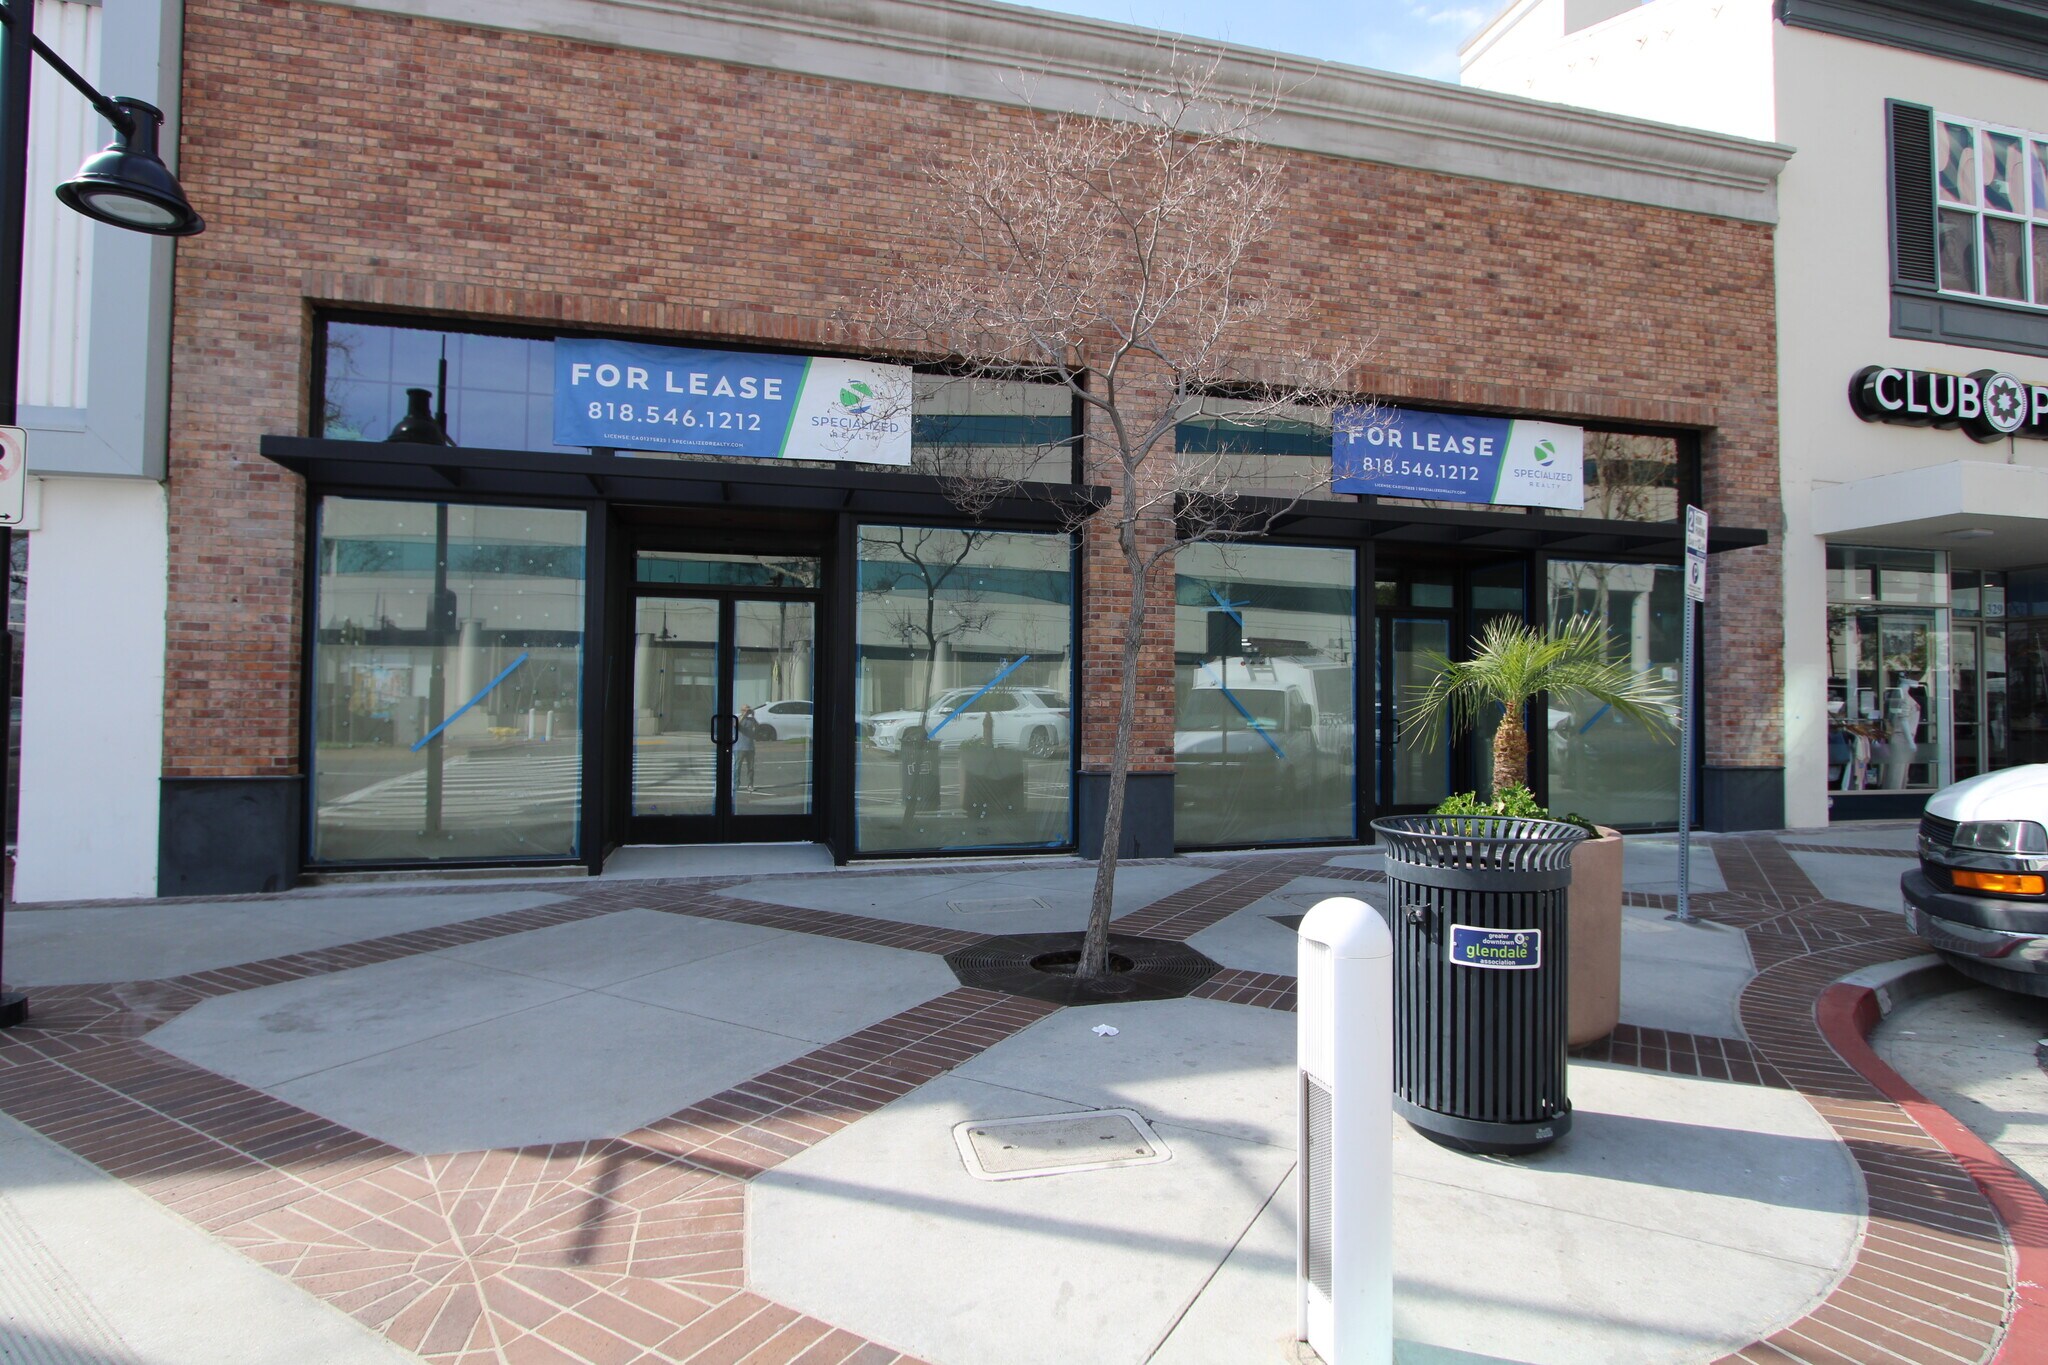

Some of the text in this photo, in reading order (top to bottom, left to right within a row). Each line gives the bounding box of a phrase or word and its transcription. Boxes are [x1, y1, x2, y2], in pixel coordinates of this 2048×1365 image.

[572, 363, 782, 400] FOR LEASE
[1875, 368, 1981, 419] CLUB
[588, 402, 760, 431] 818.546.1212
[811, 416, 899, 433] SPECIALIZED
[1349, 426, 1494, 456] FOR LEASE
[1363, 457, 1479, 481] 818.546.1212
[1514, 469, 1573, 482] SPECIALIZED
[1529, 481, 1561, 489] REALTY
[1688, 511, 1694, 531] 2
[1985, 603, 2004, 615] 329
[1466, 943, 1528, 958] glendale
